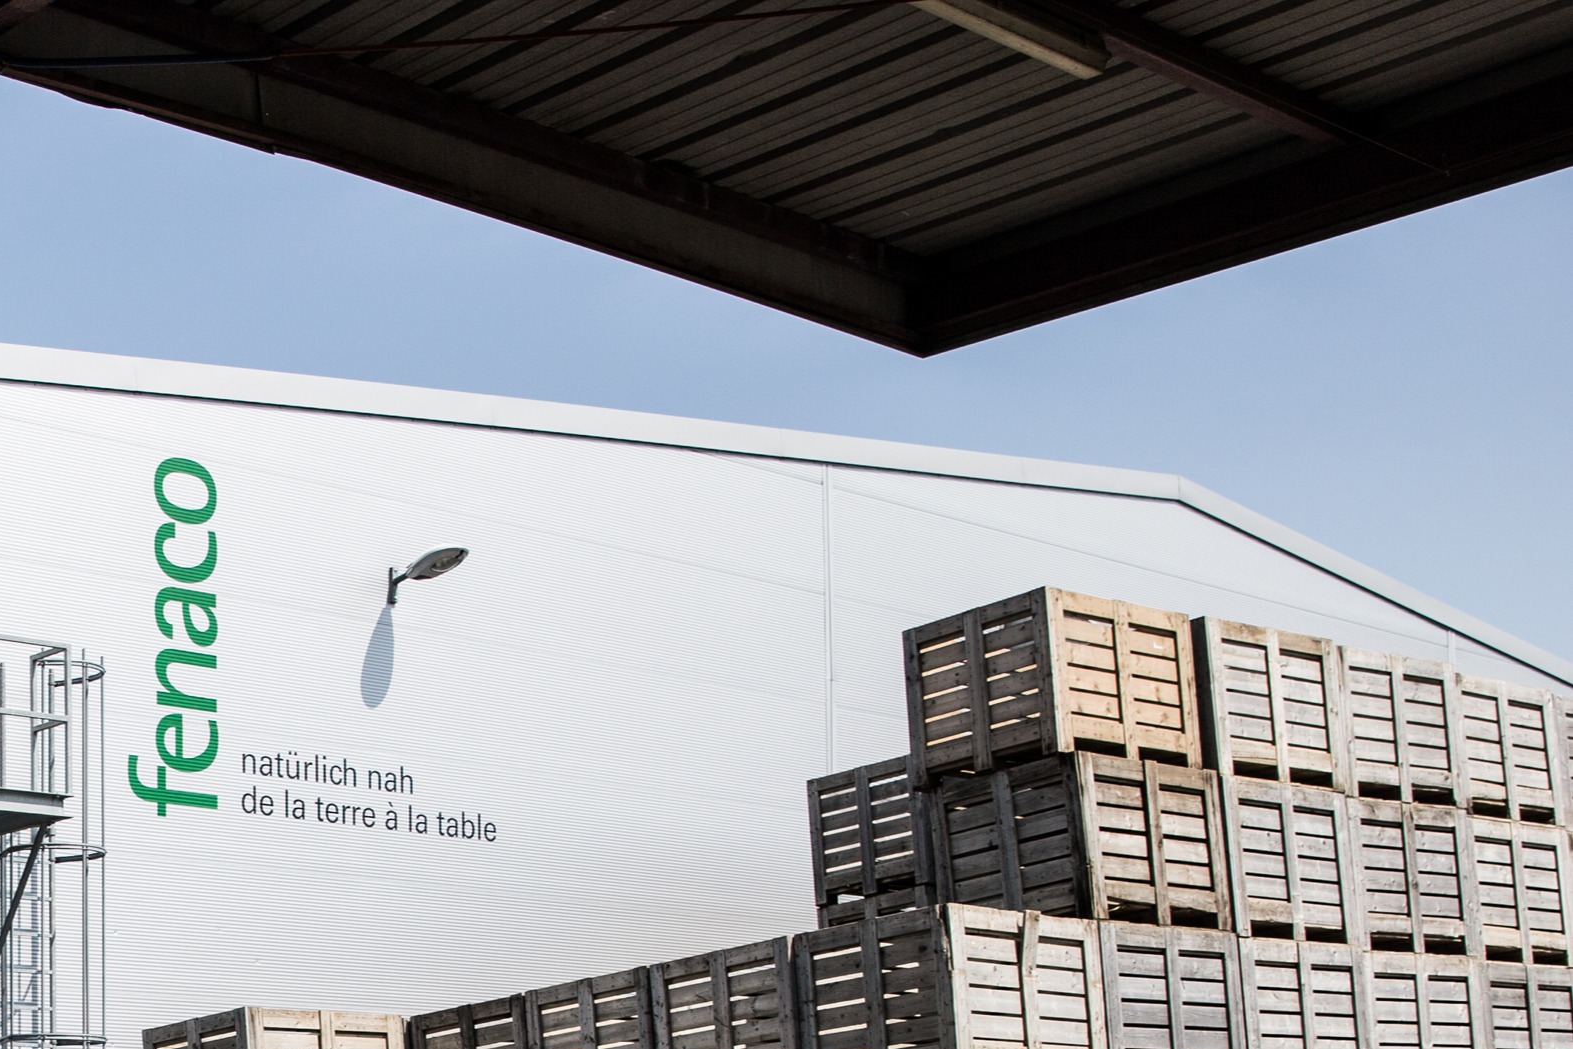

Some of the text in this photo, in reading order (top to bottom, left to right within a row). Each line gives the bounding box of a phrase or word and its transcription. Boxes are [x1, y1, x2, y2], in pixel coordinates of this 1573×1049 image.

[127, 456, 219, 817] fenaco
[241, 751, 414, 795] natürlich nah
[241, 785, 497, 843] de la terre à la table
